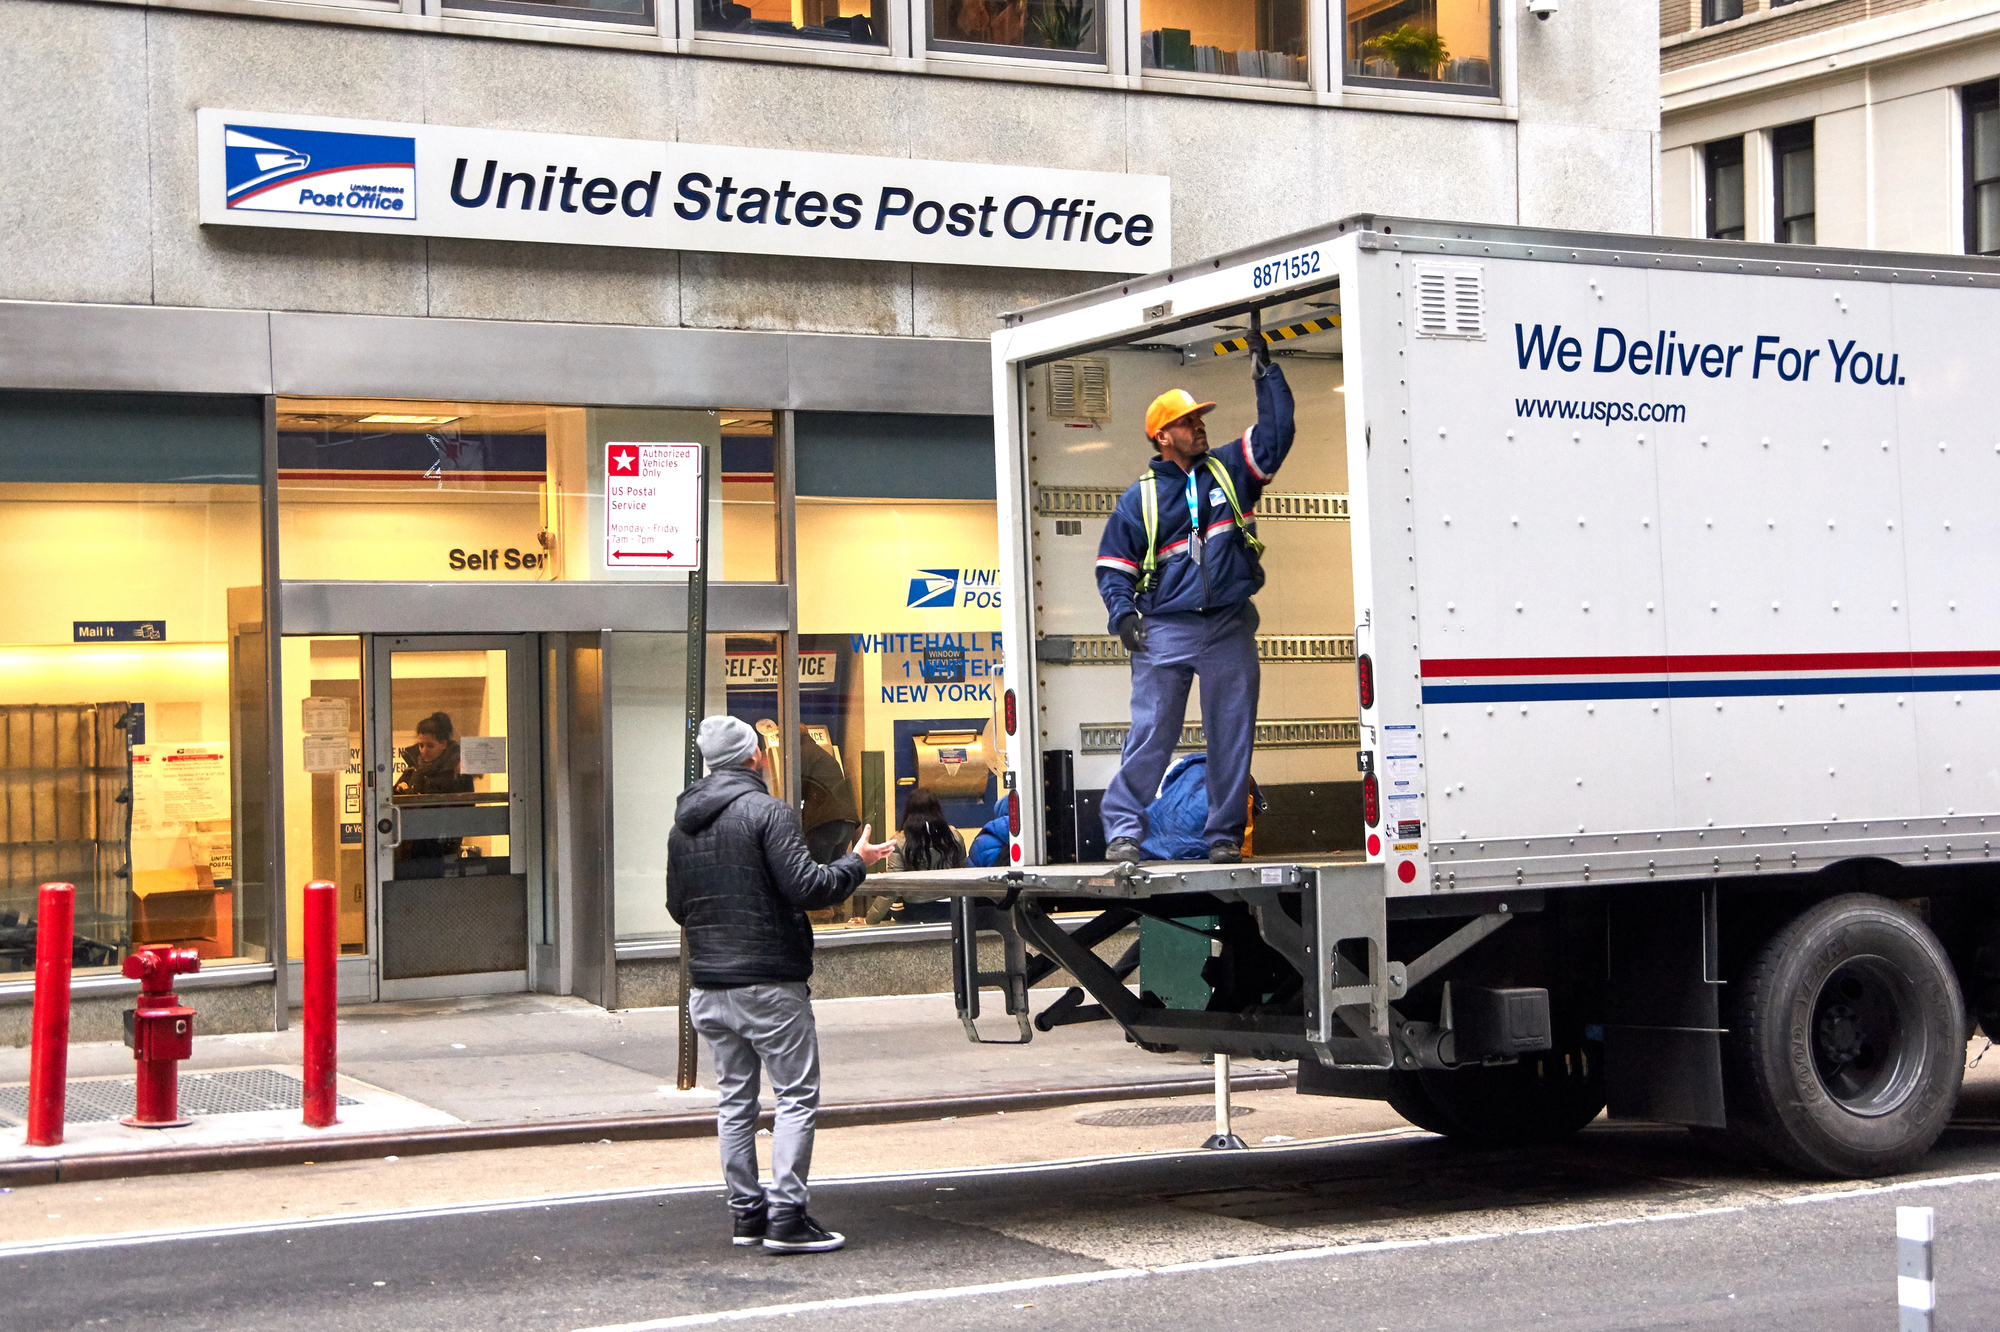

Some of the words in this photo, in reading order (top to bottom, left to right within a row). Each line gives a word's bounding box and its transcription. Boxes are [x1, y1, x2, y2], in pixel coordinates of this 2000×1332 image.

[350, 183, 377, 193] United
[379, 185, 404, 194] States
[449, 158, 662, 217] United
[673, 171, 865, 231] States
[875, 186, 998, 238] Post
[1002, 194, 1155, 247] Office
[1253, 250, 1321, 289] 8871552
[1514, 323, 1582, 373] We
[1593, 327, 1743, 379] Deliver
[1752, 335, 1820, 382] For
[1827, 338, 1906, 386] You.
[1515, 398, 1686, 427] www.usps.com
[643, 449, 691, 459] Authorized
[642, 458, 678, 468] Vehicles
[642, 468, 662, 479] Only
[611, 486, 624, 496] US
[627, 486, 656, 497] Postal
[611, 500, 647, 511] Service
[611, 523, 645, 533] Monday
[653, 523, 680, 534] Friday
[611, 534, 629, 544] 7am
[637, 534, 655, 545] 7pm
[449, 548, 499, 571] Self
[963, 568, 1000, 586] UNI
[79, 626, 103, 637] Mail
[106, 626, 114, 637] it
[850, 632, 984, 654] WHITEHALL
[902, 660, 910, 678] 1
[881, 686, 928, 704] NEW
[934, 684, 992, 702] YORK
[345, 825, 352, 833] Or
